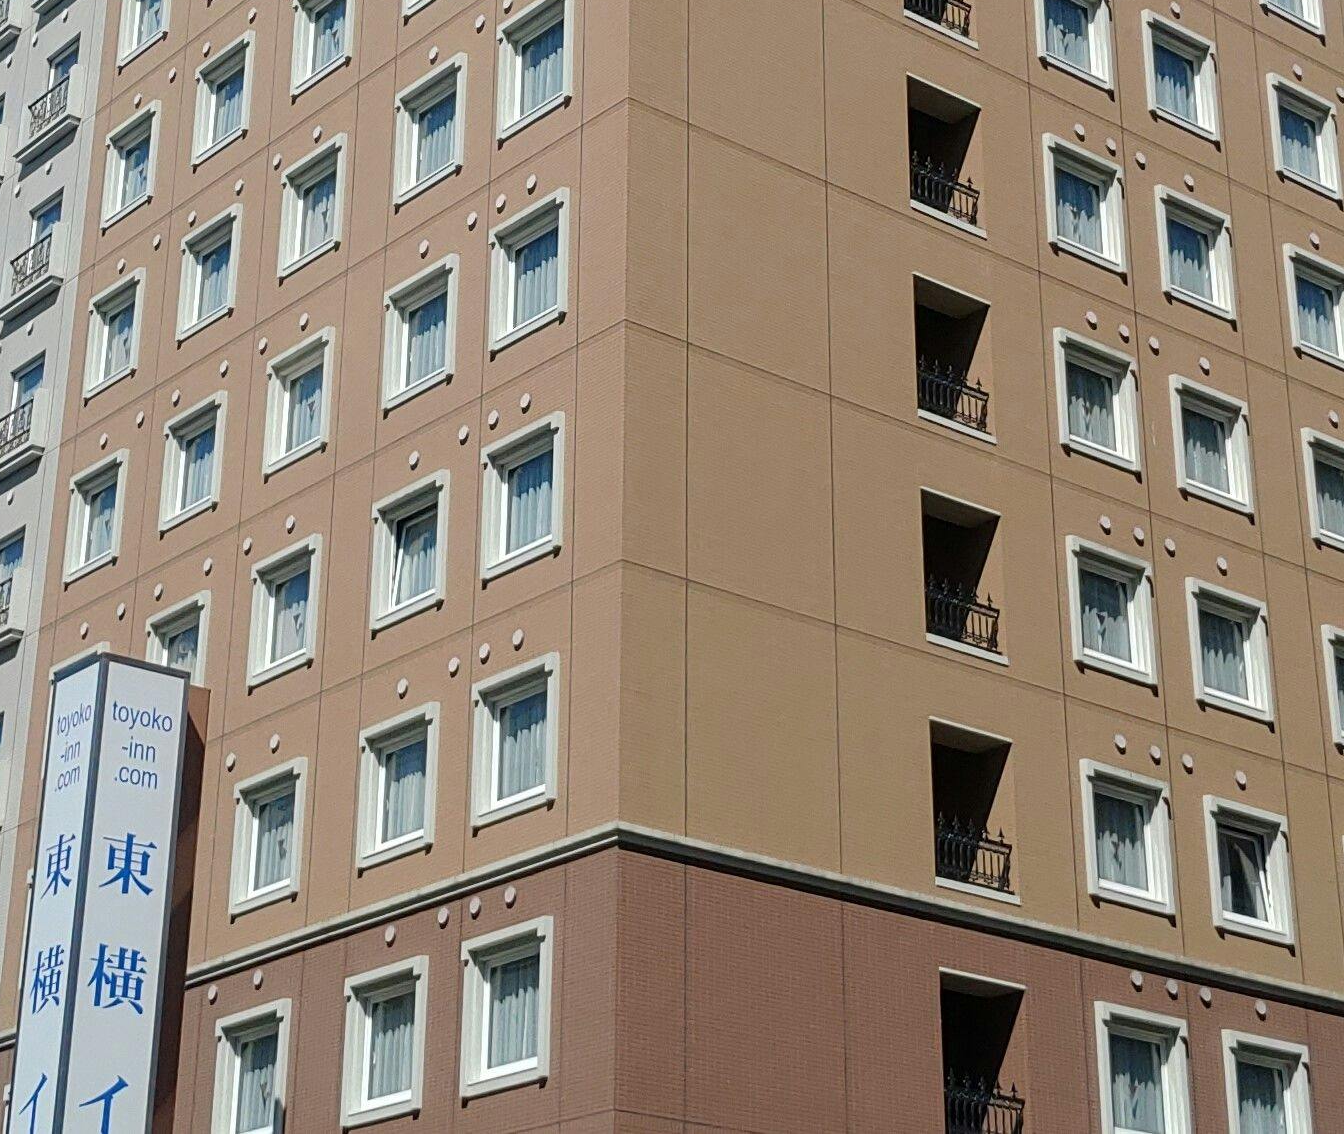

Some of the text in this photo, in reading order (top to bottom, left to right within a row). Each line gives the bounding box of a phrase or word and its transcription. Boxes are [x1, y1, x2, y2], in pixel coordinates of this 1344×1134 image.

[57, 703, 92, 736] toyoko
[113, 701, 173, 732] toyoko
[122, 736, 156, 763] -inn
[114, 766, 158, 790] .com
